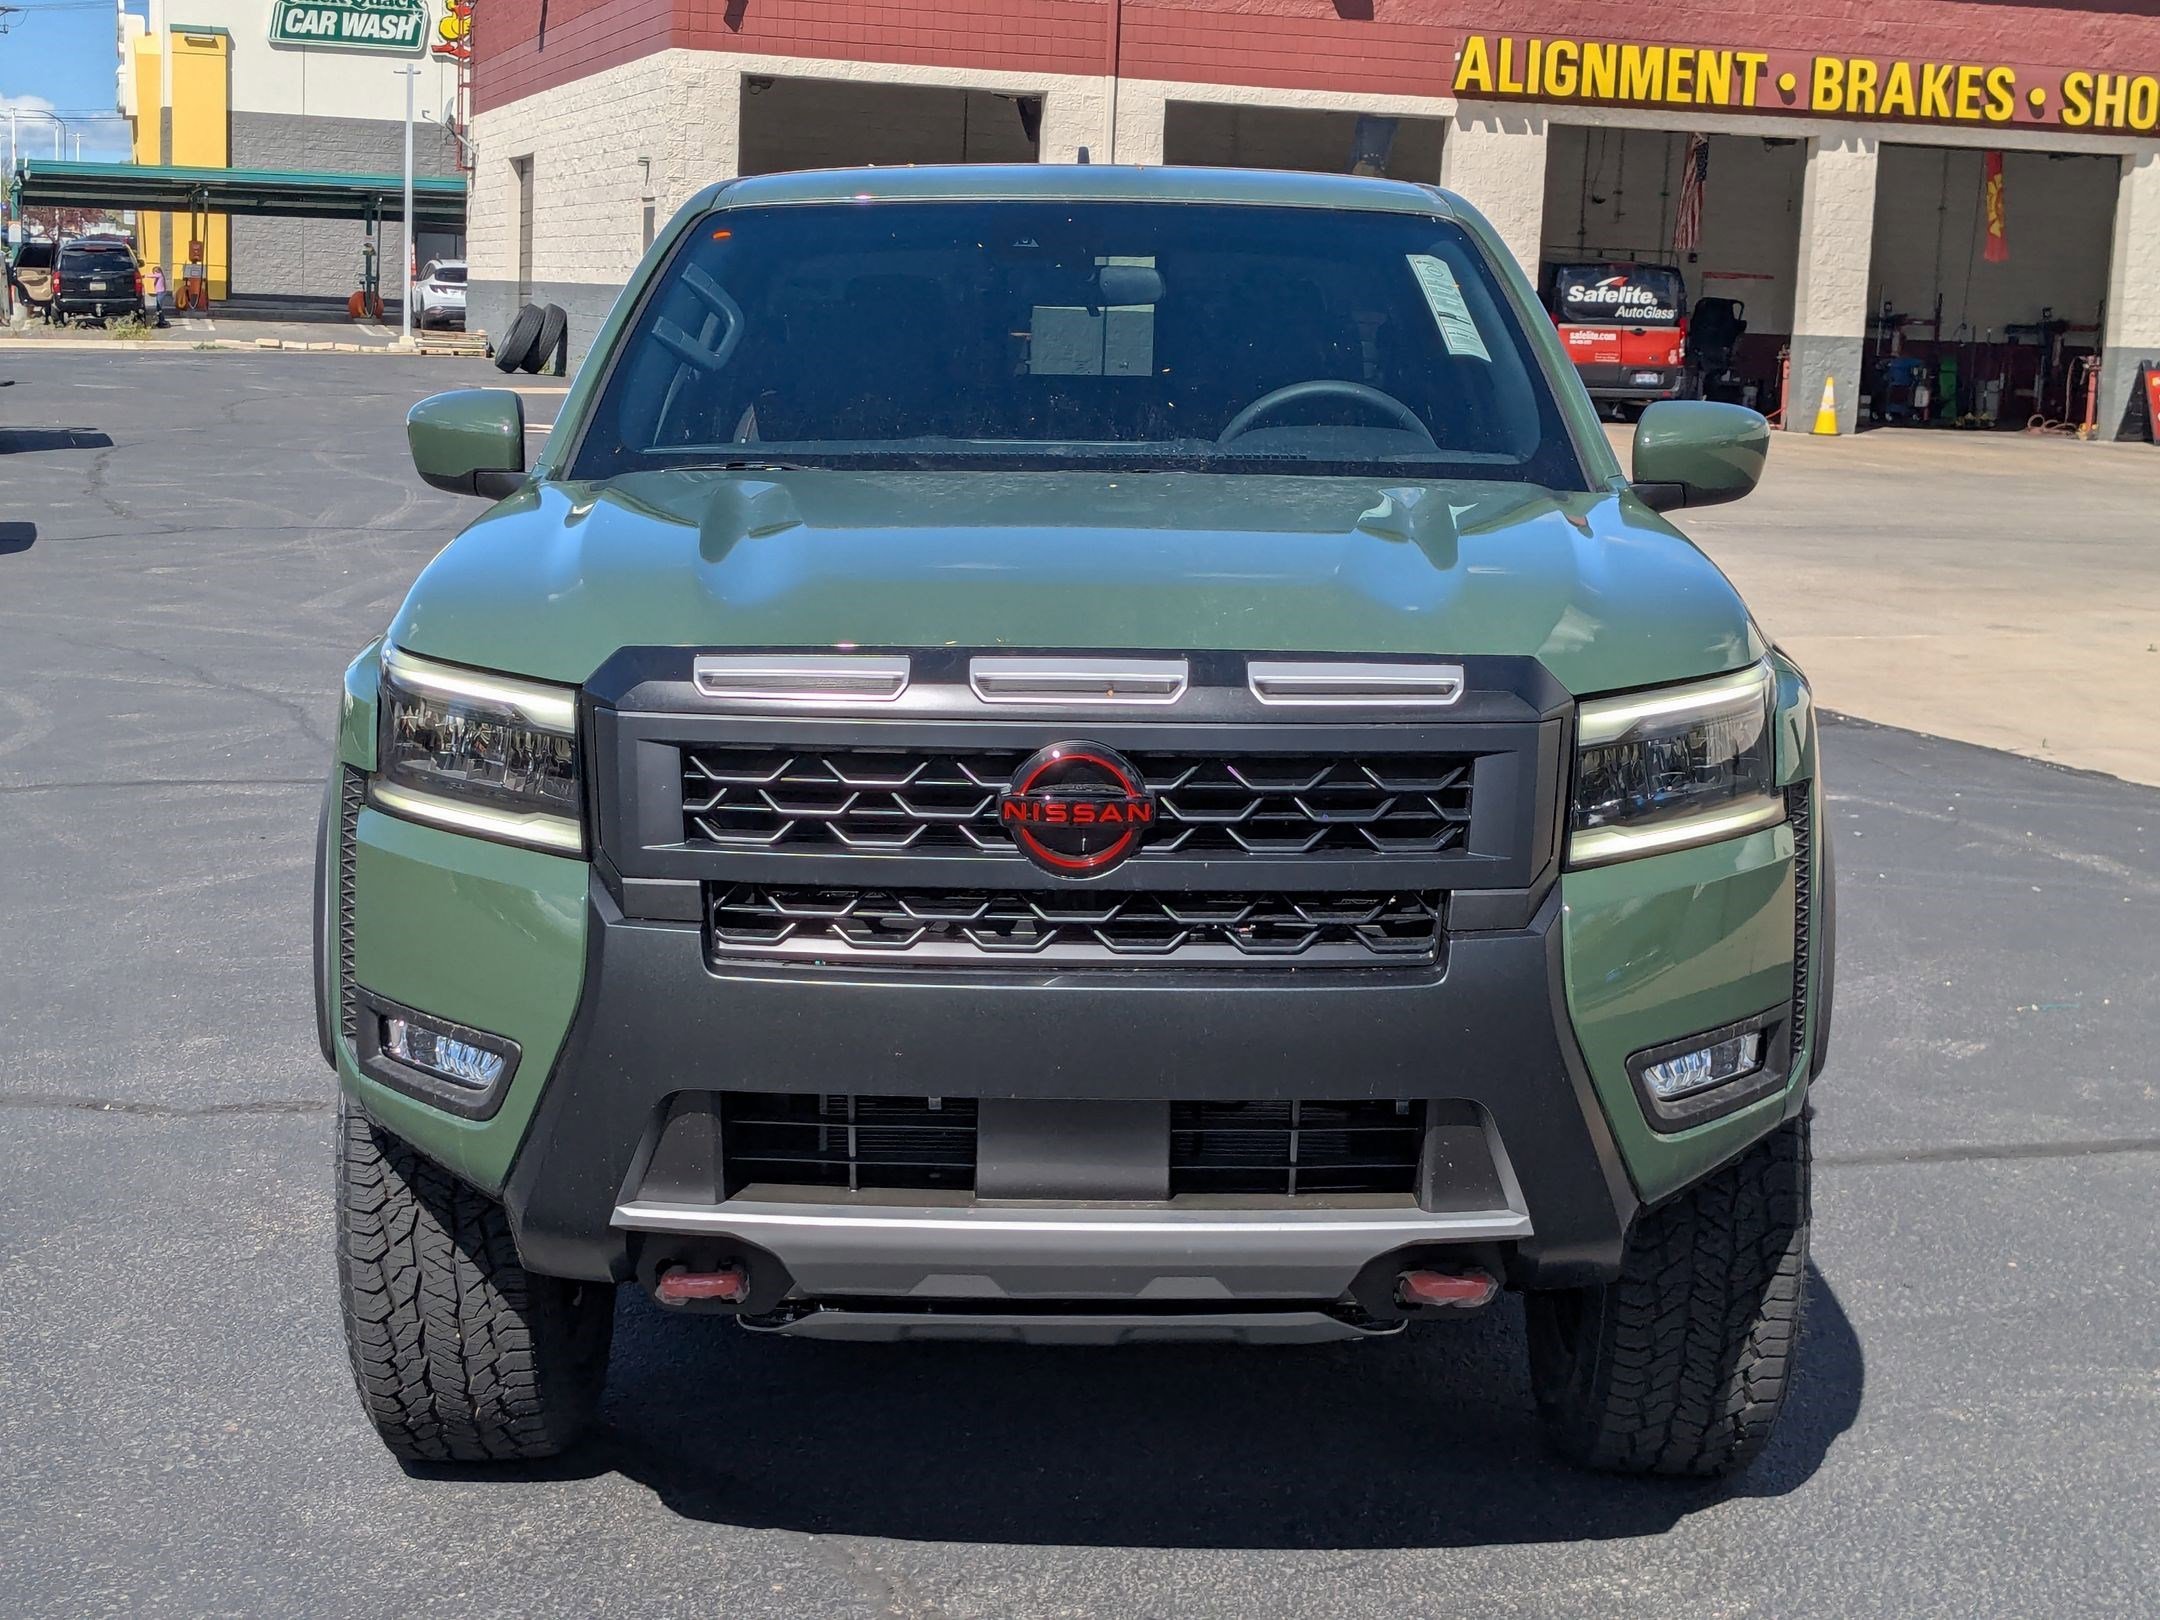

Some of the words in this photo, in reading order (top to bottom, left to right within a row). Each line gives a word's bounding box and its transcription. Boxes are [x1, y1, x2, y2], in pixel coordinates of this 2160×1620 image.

[285, 8, 337, 36] CAR
[342, 11, 416, 41] WASH
[1454, 36, 1768, 106] ALIGNMENT
[1812, 56, 2015, 121] BRAKES
[2062, 71, 2159, 130] SHO
[1567, 285, 1656, 305] Safelite
[1614, 305, 1677, 319] AutoGlass
[1003, 801, 1150, 823] NISSAN
